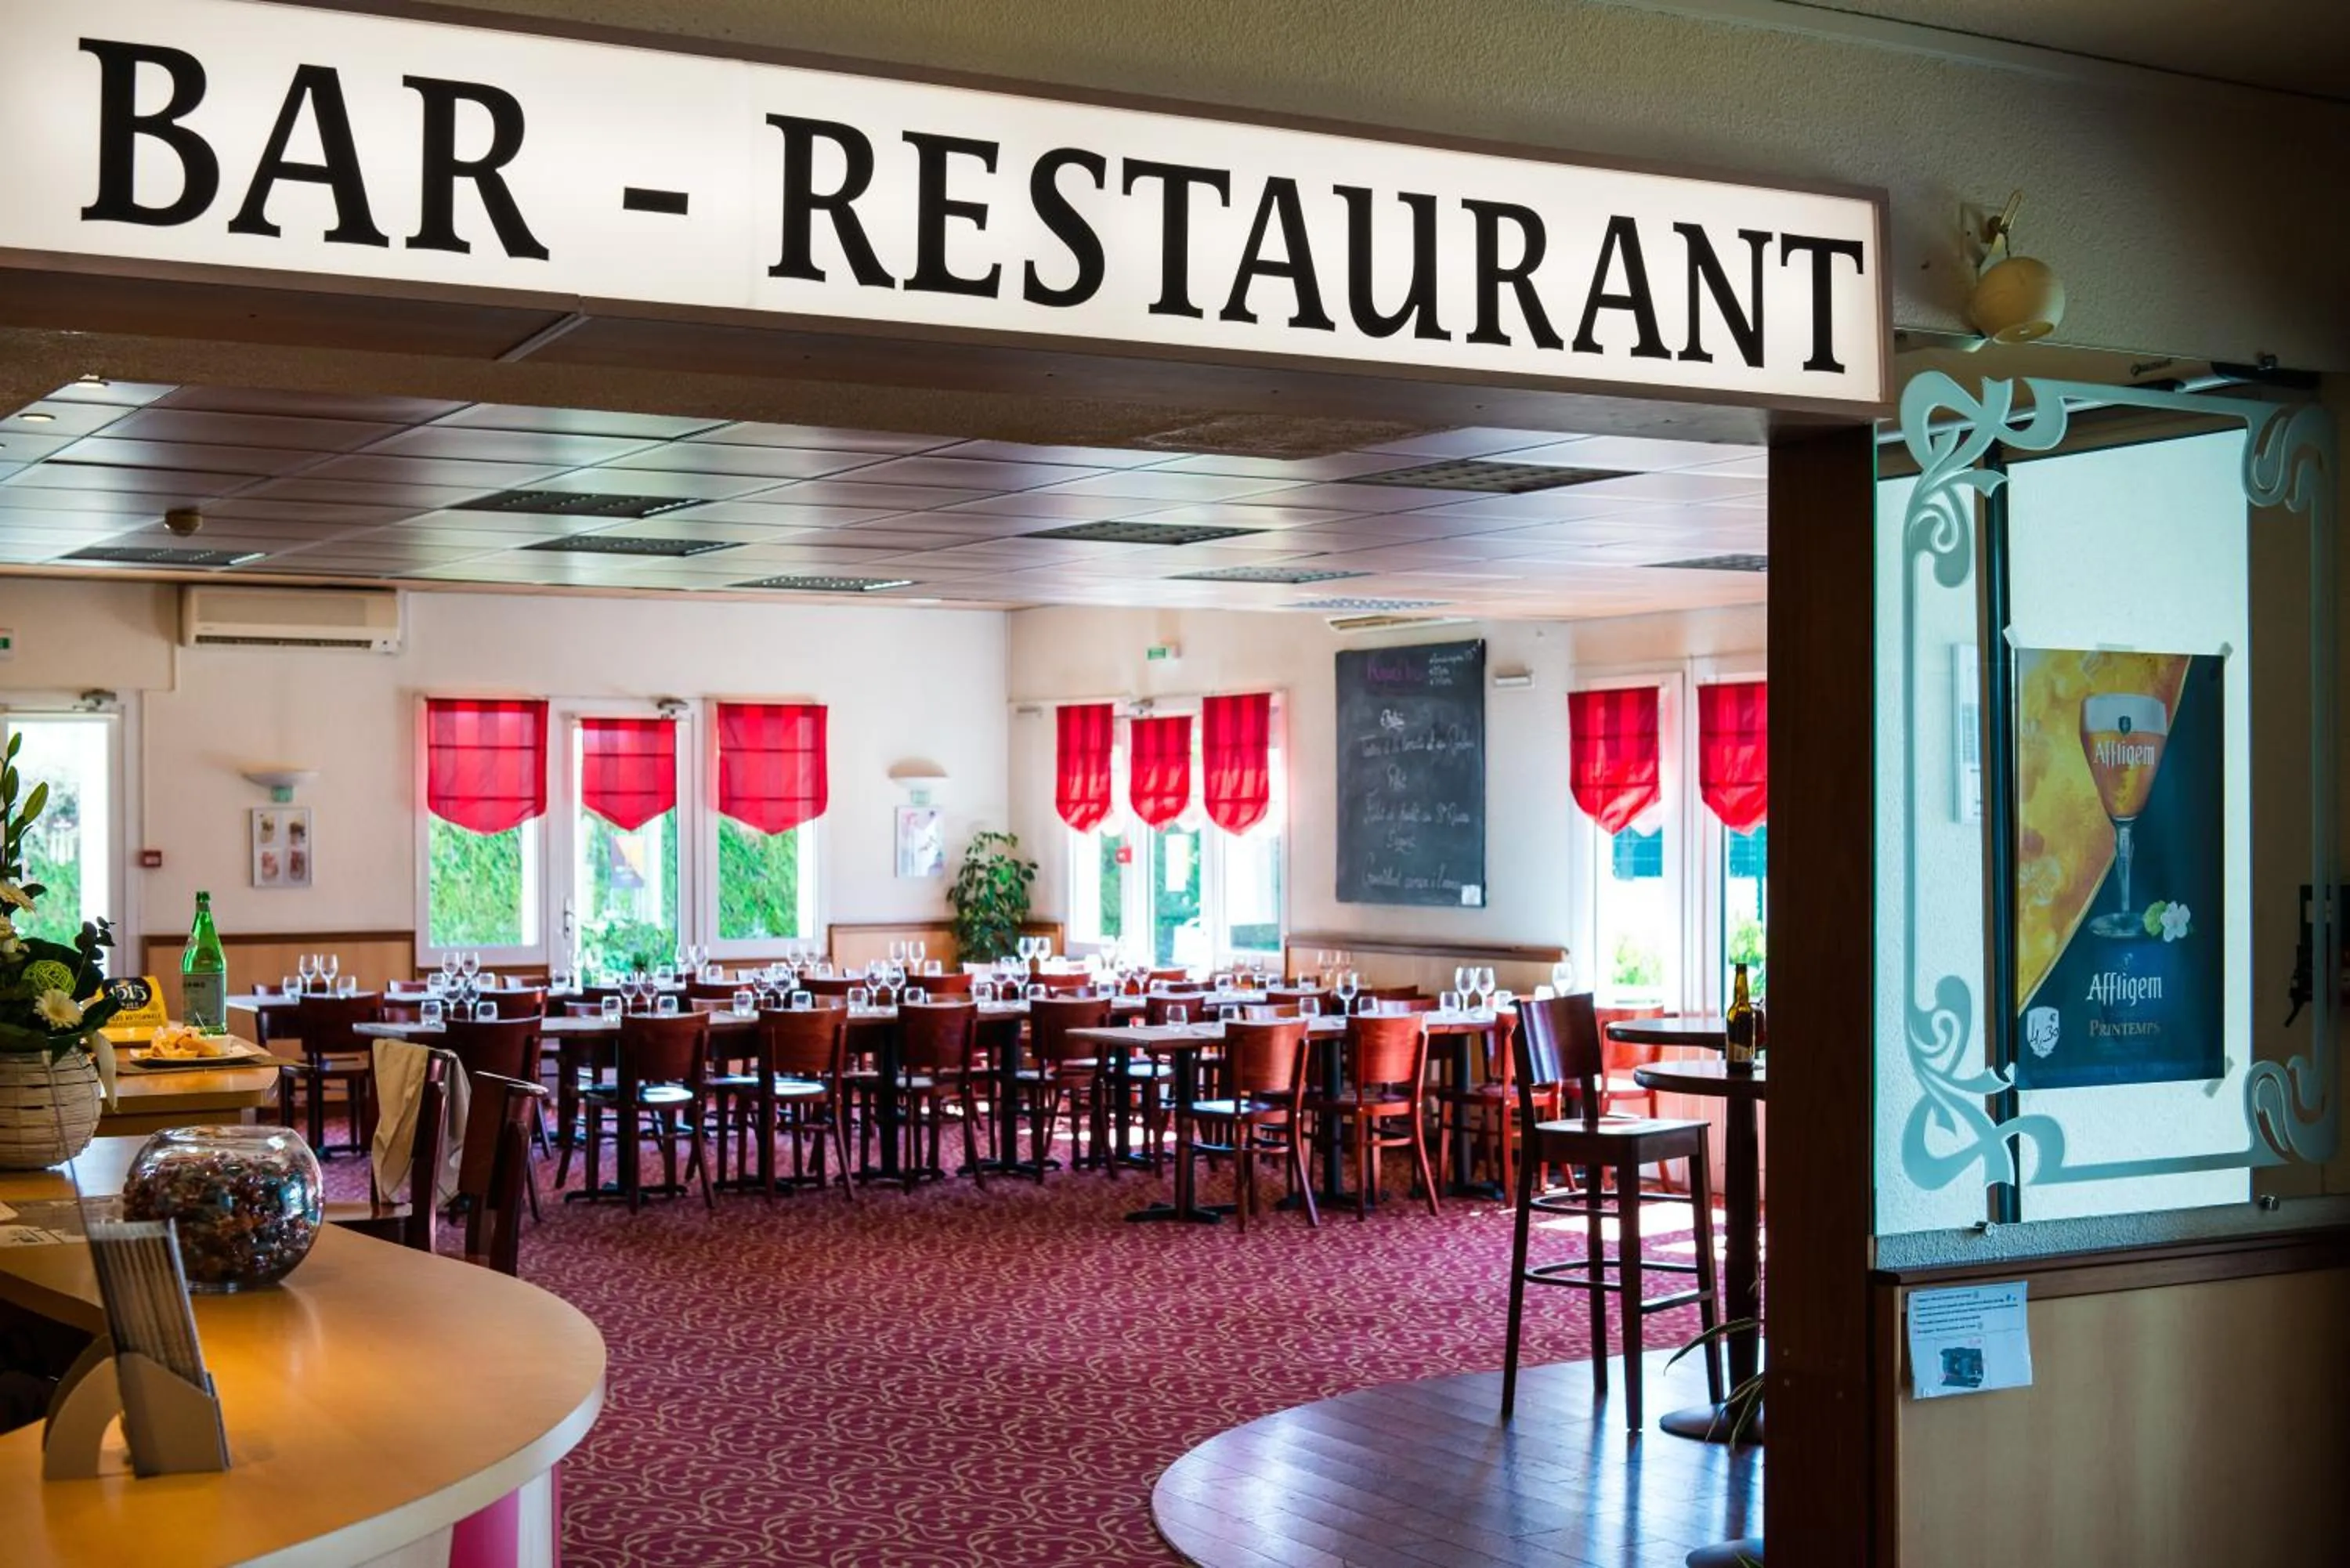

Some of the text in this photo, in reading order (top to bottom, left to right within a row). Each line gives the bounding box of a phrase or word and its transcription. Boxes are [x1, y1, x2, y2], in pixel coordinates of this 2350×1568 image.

[78, 36, 551, 262] BAR
[765, 113, 1864, 374] RESTAURANT
[2094, 739, 2155, 768] Affligem
[2086, 971, 2163, 1006] Affligem
[2090, 1019, 2160, 1037] PRINTEMPS
